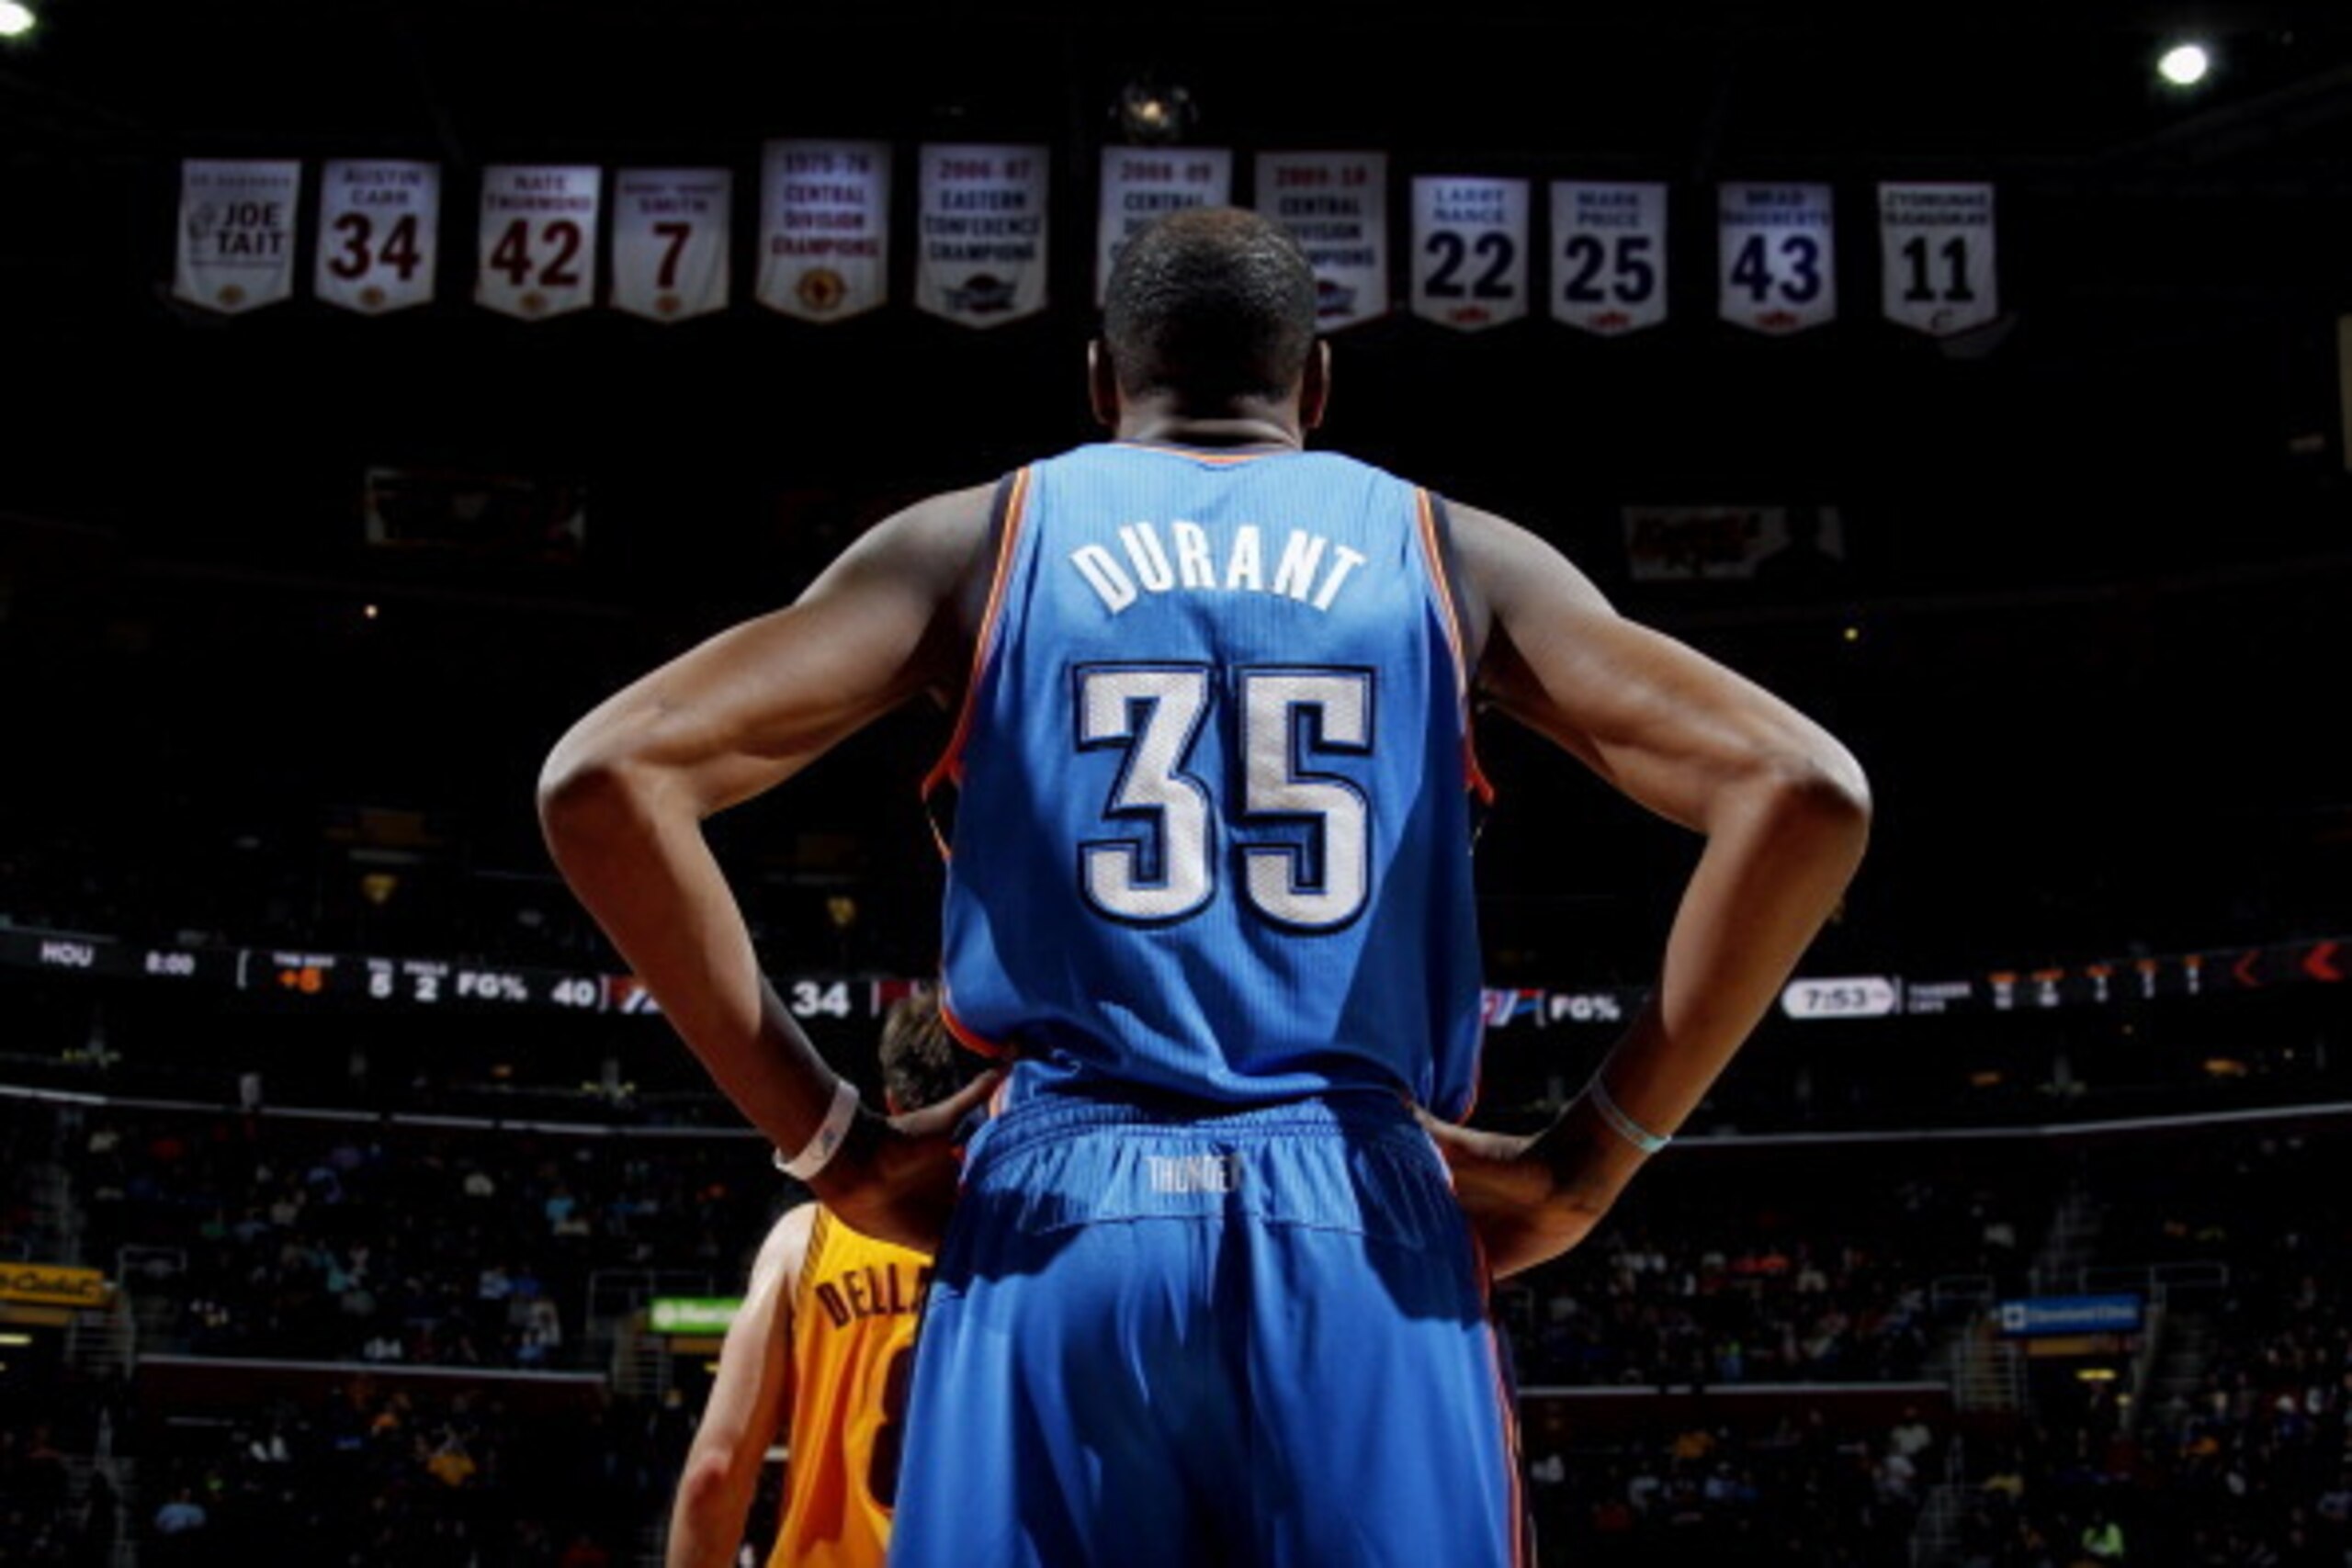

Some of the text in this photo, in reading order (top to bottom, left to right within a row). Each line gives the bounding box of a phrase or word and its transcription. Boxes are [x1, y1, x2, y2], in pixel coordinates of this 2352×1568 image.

[785, 185, 865, 204] CENTRAL
[940, 188, 1026, 210] EASTERN
[1279, 197, 1363, 216] CENTRAL
[224, 201, 282, 228] JOE
[784, 210, 865, 230] DIVISION
[924, 215, 1041, 235] CONFERENCE
[217, 230, 284, 255] TAIT
[328, 212, 421, 279] 34
[490, 219, 582, 287] 42
[653, 220, 691, 289] 7
[771, 235, 879, 256] CHAMPIONS
[929, 241, 1035, 262] CHAMPIONS
[1424, 231, 1514, 299] 22
[1565, 234, 1654, 303] 25
[1730, 234, 1821, 303] 43
[1900, 236, 1974, 301] 11
[1070, 521, 1367, 615] DURANT
[1072, 660, 1375, 934] 35
[40, 940, 95, 967] HOU
[414, 976, 438, 1002] 2
[457, 971, 528, 1002] FG%
[551, 976, 595, 1008] 40
[791, 979, 852, 1018] 34
[1804, 986, 1869, 1010] 7:53
[1550, 993, 1621, 1022] FG%
